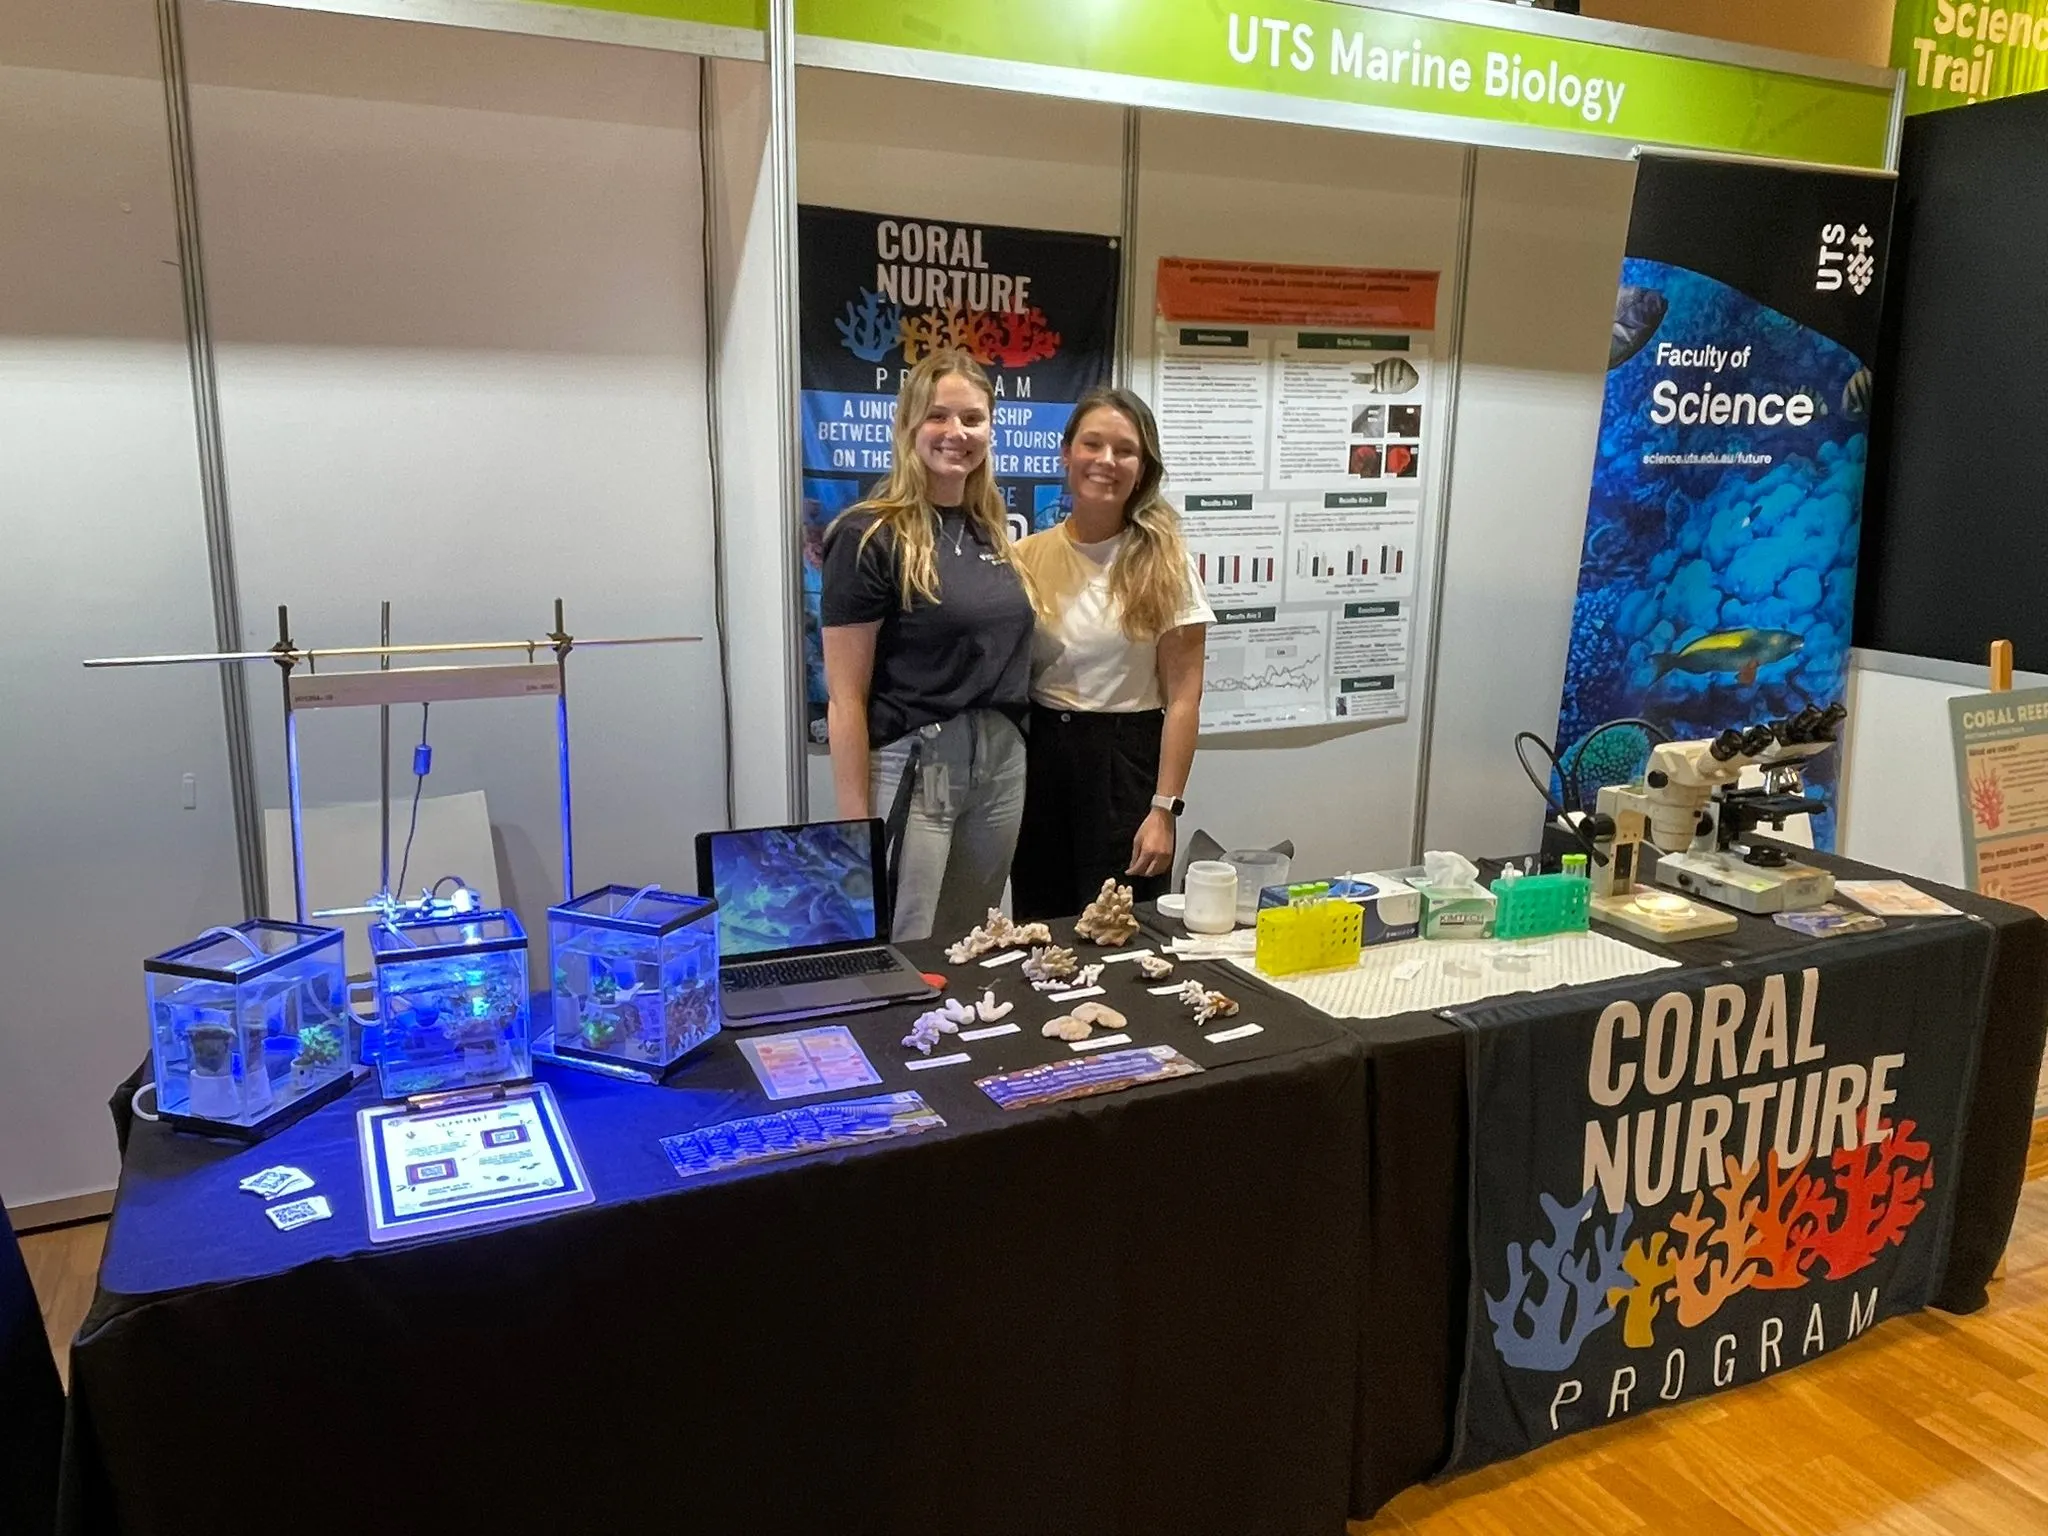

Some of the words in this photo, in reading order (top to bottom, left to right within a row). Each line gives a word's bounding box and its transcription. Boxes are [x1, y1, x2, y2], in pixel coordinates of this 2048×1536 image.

[1226, 13, 1315, 71] UTS
[1330, 29, 1472, 92] Marine
[1484, 52, 1626, 124] Biology
[1913, 37, 1995, 97] Trail
[876, 220, 989, 269] CORAL
[1815, 223, 1846, 291] UTS
[876, 262, 1032, 315] NURTURE
[1656, 342, 1728, 372] Faculty
[1730, 345, 1752, 368] of
[843, 399, 854, 418] A
[1650, 379, 1815, 426] Science
[818, 421, 894, 443] BETWEEN
[833, 448, 856, 468] ON
[861, 449, 893, 469] THE
[1023, 455, 1062, 474] REEF
[1642, 451, 1773, 465] science.uts.edu.au/future
[1963, 706, 2016, 730] CORAL
[1587, 967, 1826, 1107] CORAL
[1580, 1052, 1905, 1222] NURTURE
[1549, 1287, 1880, 1430] PROGRAM
